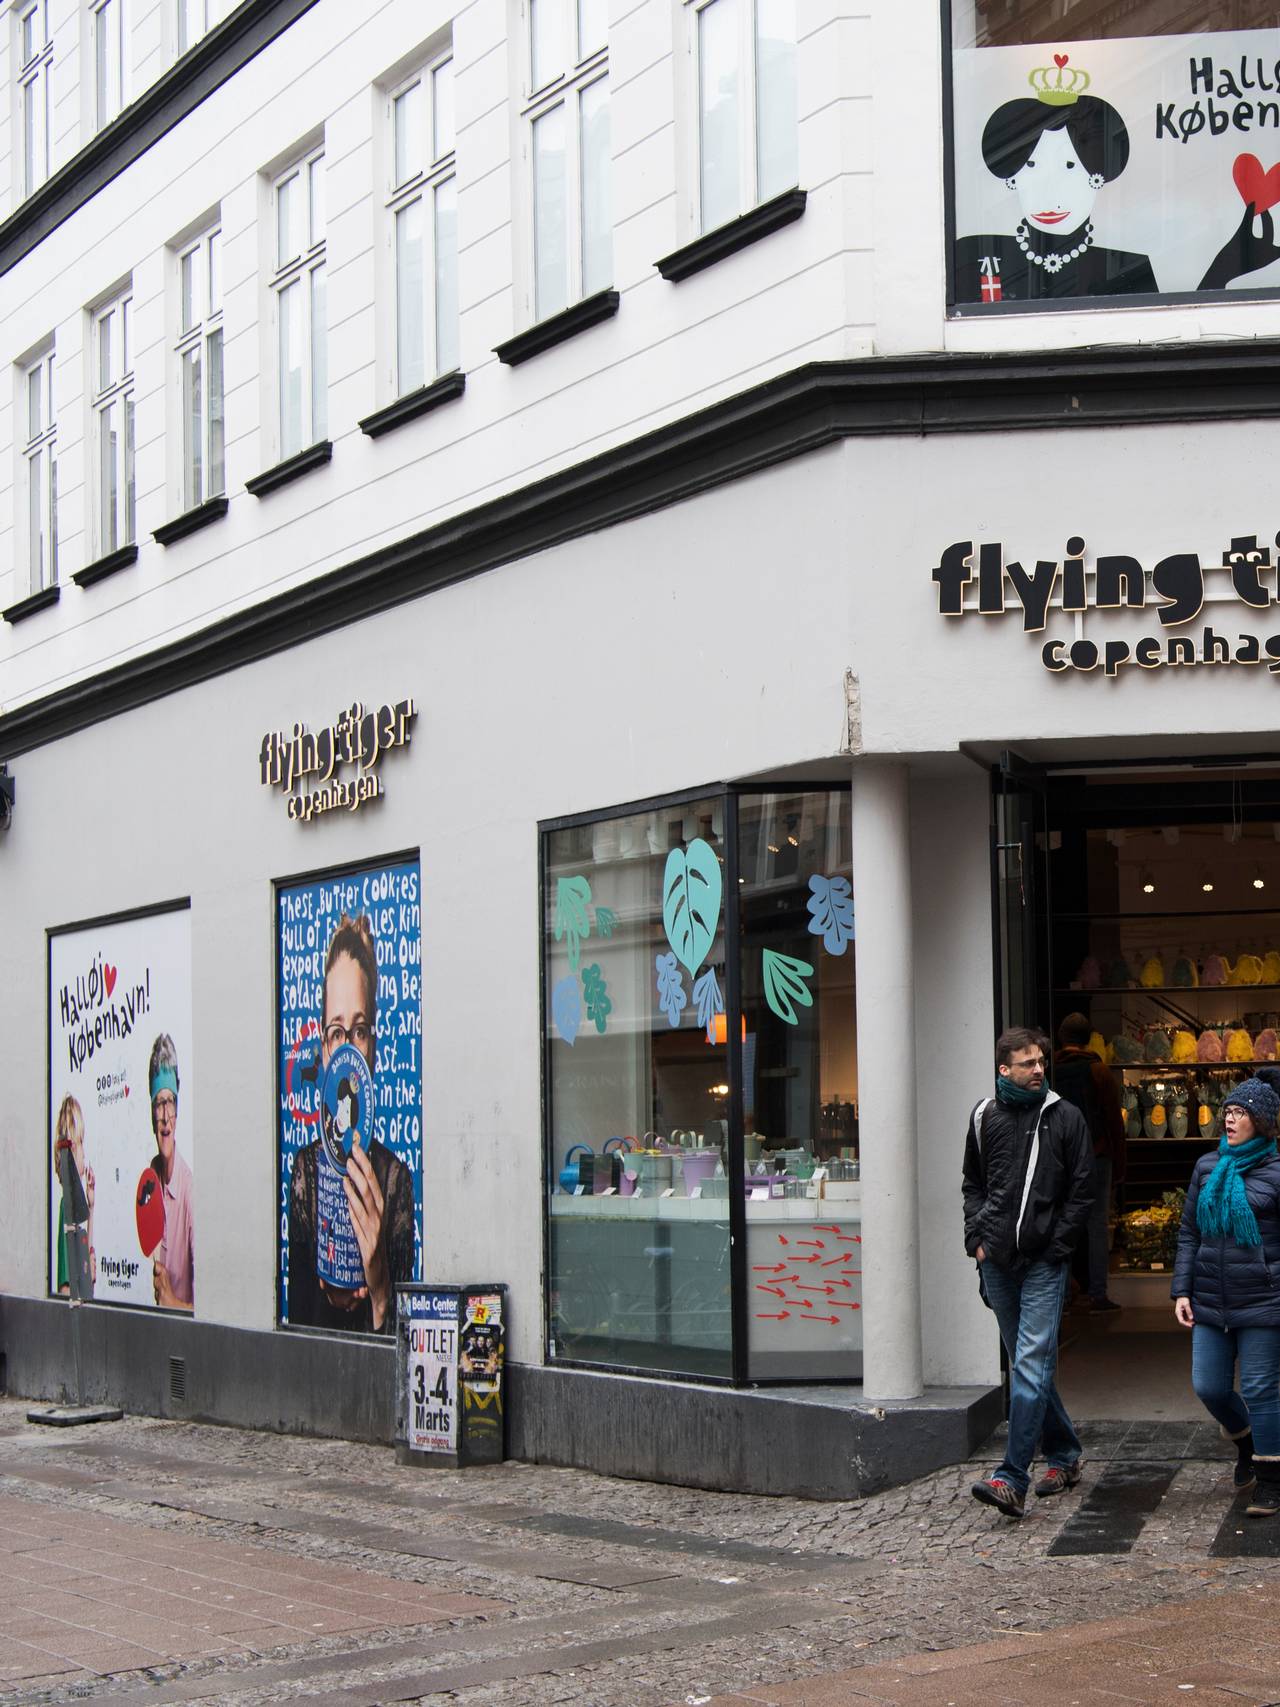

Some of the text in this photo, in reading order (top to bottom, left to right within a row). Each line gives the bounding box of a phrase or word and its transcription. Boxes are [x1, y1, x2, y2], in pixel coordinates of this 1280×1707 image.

[931, 535, 1205, 632] flying
[259, 698, 414, 794] flying tiger
[288, 774, 380, 822] copenhagen
[60, 952, 104, 1027] Halløj
[402, 969, 421, 1001] Be
[68, 968, 150, 1073] København!
[395, 1079, 415, 1108] the
[101, 1257, 139, 1279] flying tiger
[412, 1295, 431, 1311] Bella
[432, 1297, 457, 1312] Center
[411, 1328, 455, 1354] OUTLET
[413, 1365, 453, 1406] 3.-4.
[415, 1406, 450, 1432] Marts
